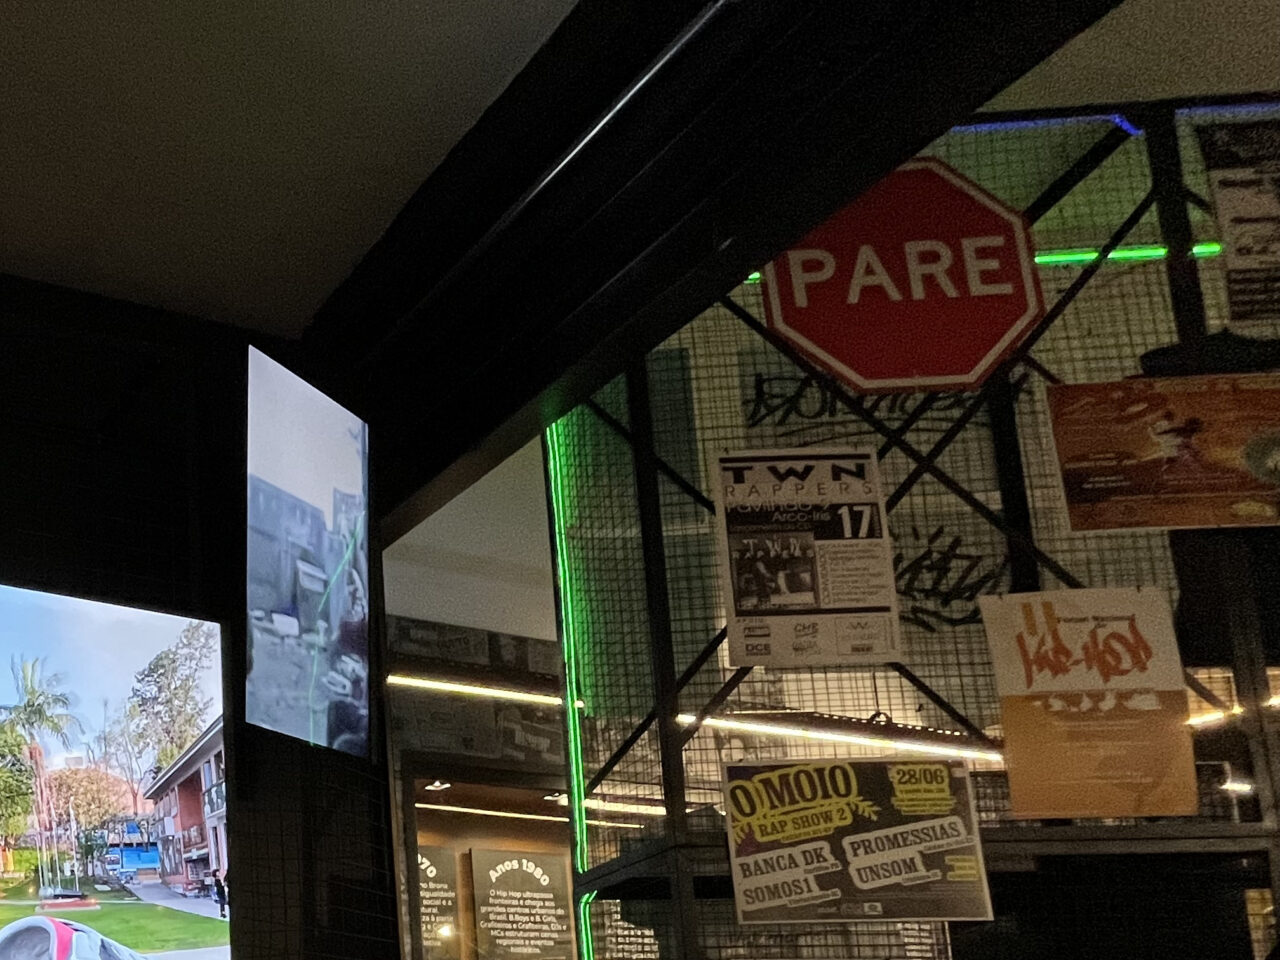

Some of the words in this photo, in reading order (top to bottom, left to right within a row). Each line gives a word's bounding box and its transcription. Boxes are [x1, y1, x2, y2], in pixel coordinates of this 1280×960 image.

[787, 236, 1013, 308] PARE
[725, 481, 872, 498] RAPPERS
[837, 505, 872, 538] 17
[896, 768, 945, 785] 28/06
[758, 821, 788, 838] RAP
[791, 810, 834, 831] SHOW
[838, 807, 847, 821] 2
[848, 822, 961, 857] PROMESSIAS
[489, 859, 519, 883] Anos
[521, 858, 550, 886] 1980
[738, 853, 800, 878] BANCA
[800, 846, 828, 866] DK
[855, 857, 920, 883] UNSOM
[496, 890, 508, 898] Hip
[508, 890, 522, 899] Hop
